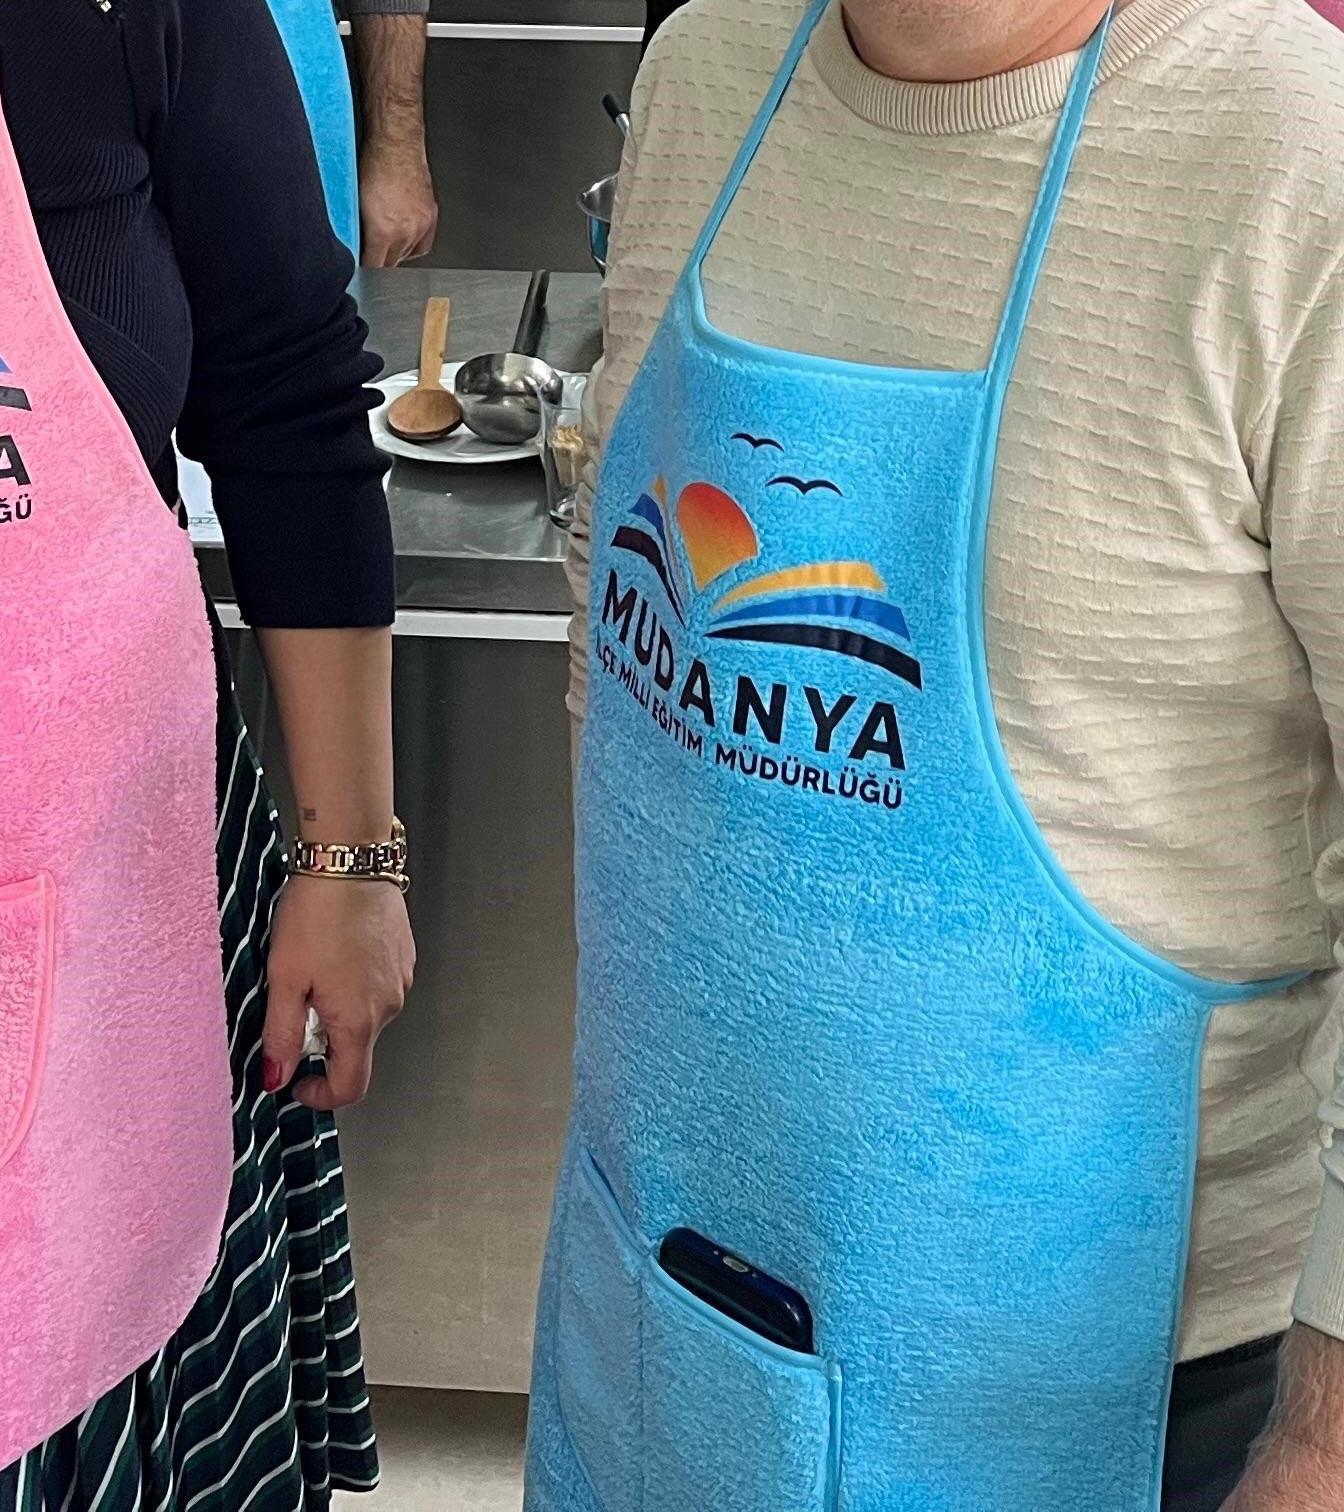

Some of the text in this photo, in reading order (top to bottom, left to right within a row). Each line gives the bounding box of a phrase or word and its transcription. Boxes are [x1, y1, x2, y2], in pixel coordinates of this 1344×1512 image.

[601, 567, 907, 772] MUDANYA
[618, 660, 652, 711] MİLLİ
[651, 694, 704, 759] EĞİTİM
[715, 742, 903, 811] MÜDÜRLÜĞÜ
